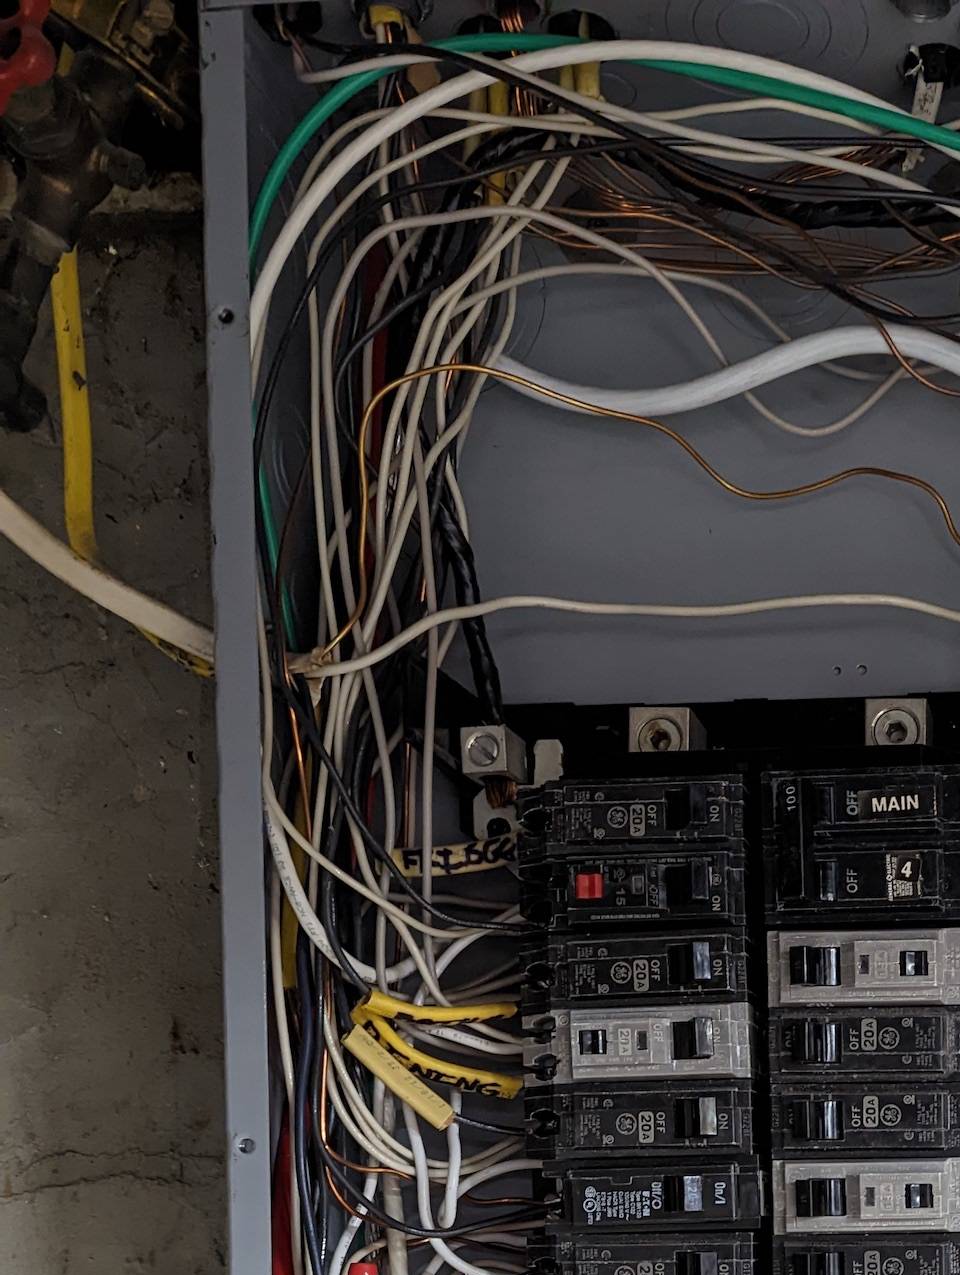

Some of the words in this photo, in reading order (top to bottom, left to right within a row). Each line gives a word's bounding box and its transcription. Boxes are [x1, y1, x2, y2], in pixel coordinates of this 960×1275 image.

[785, 785, 796, 812] 100
[846, 789, 858, 816] OFF
[871, 794, 920, 813] MAIN
[631, 806, 644, 835] 20A
[647, 805, 657, 826] OFF
[710, 805, 720, 823] ON
[901, 861, 912, 878] 4
[846, 868, 858, 894] OFF
[615, 888, 626, 906] 15
[649, 885, 659, 907] OFF
[712, 895, 721, 911] ON
[634, 962, 647, 990] 20A
[650, 960, 660, 982] OFF
[713, 959, 722, 976] ON
[849, 1028, 859, 1051] OFF
[863, 1021, 875, 1048] 20A
[655, 1112, 666, 1133] OFF
[718, 1113, 729, 1130] ON
[851, 1105, 861, 1128] OFF
[865, 1098, 876, 1125] 20A
[640, 1113, 653, 1141] 20A
